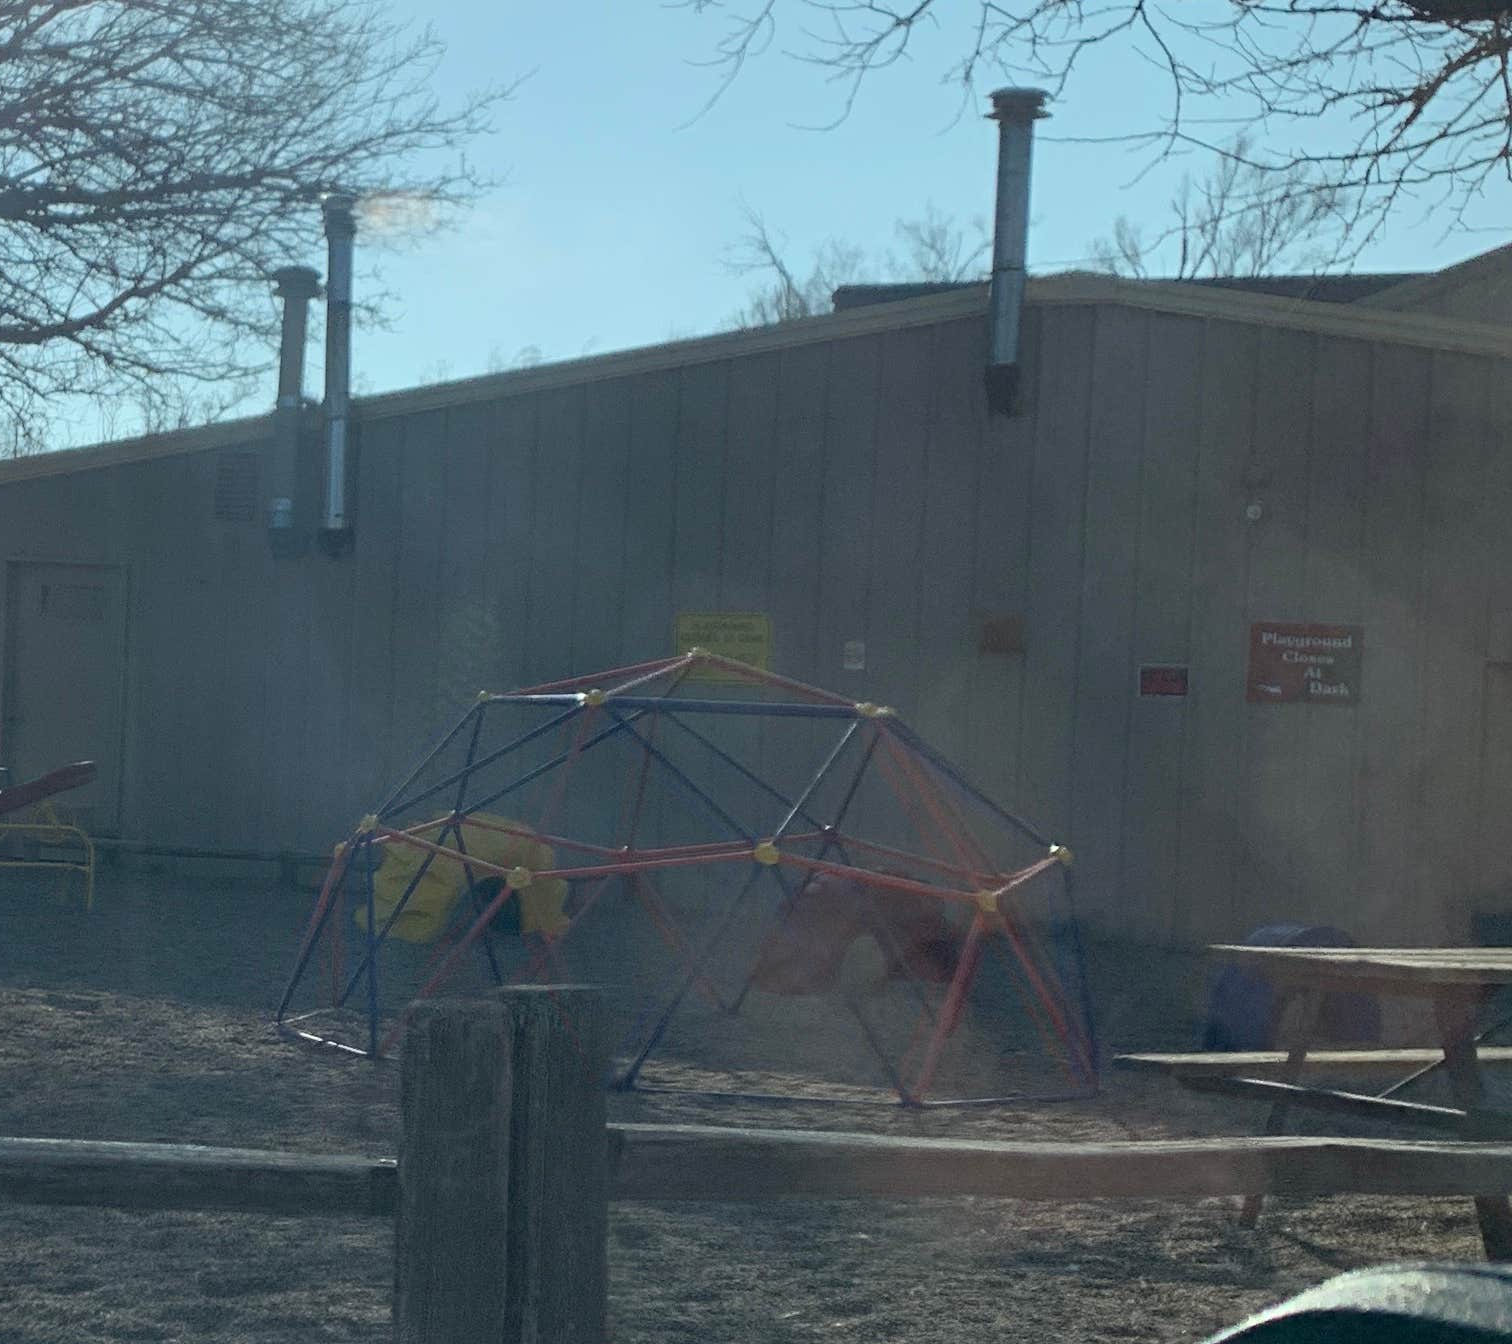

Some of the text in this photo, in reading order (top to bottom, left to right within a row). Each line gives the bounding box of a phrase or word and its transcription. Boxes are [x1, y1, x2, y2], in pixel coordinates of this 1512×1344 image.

[1262, 632, 1352, 649] Playground
[1282, 650, 1335, 665] Closes
[1309, 681, 1350, 695] Dark
